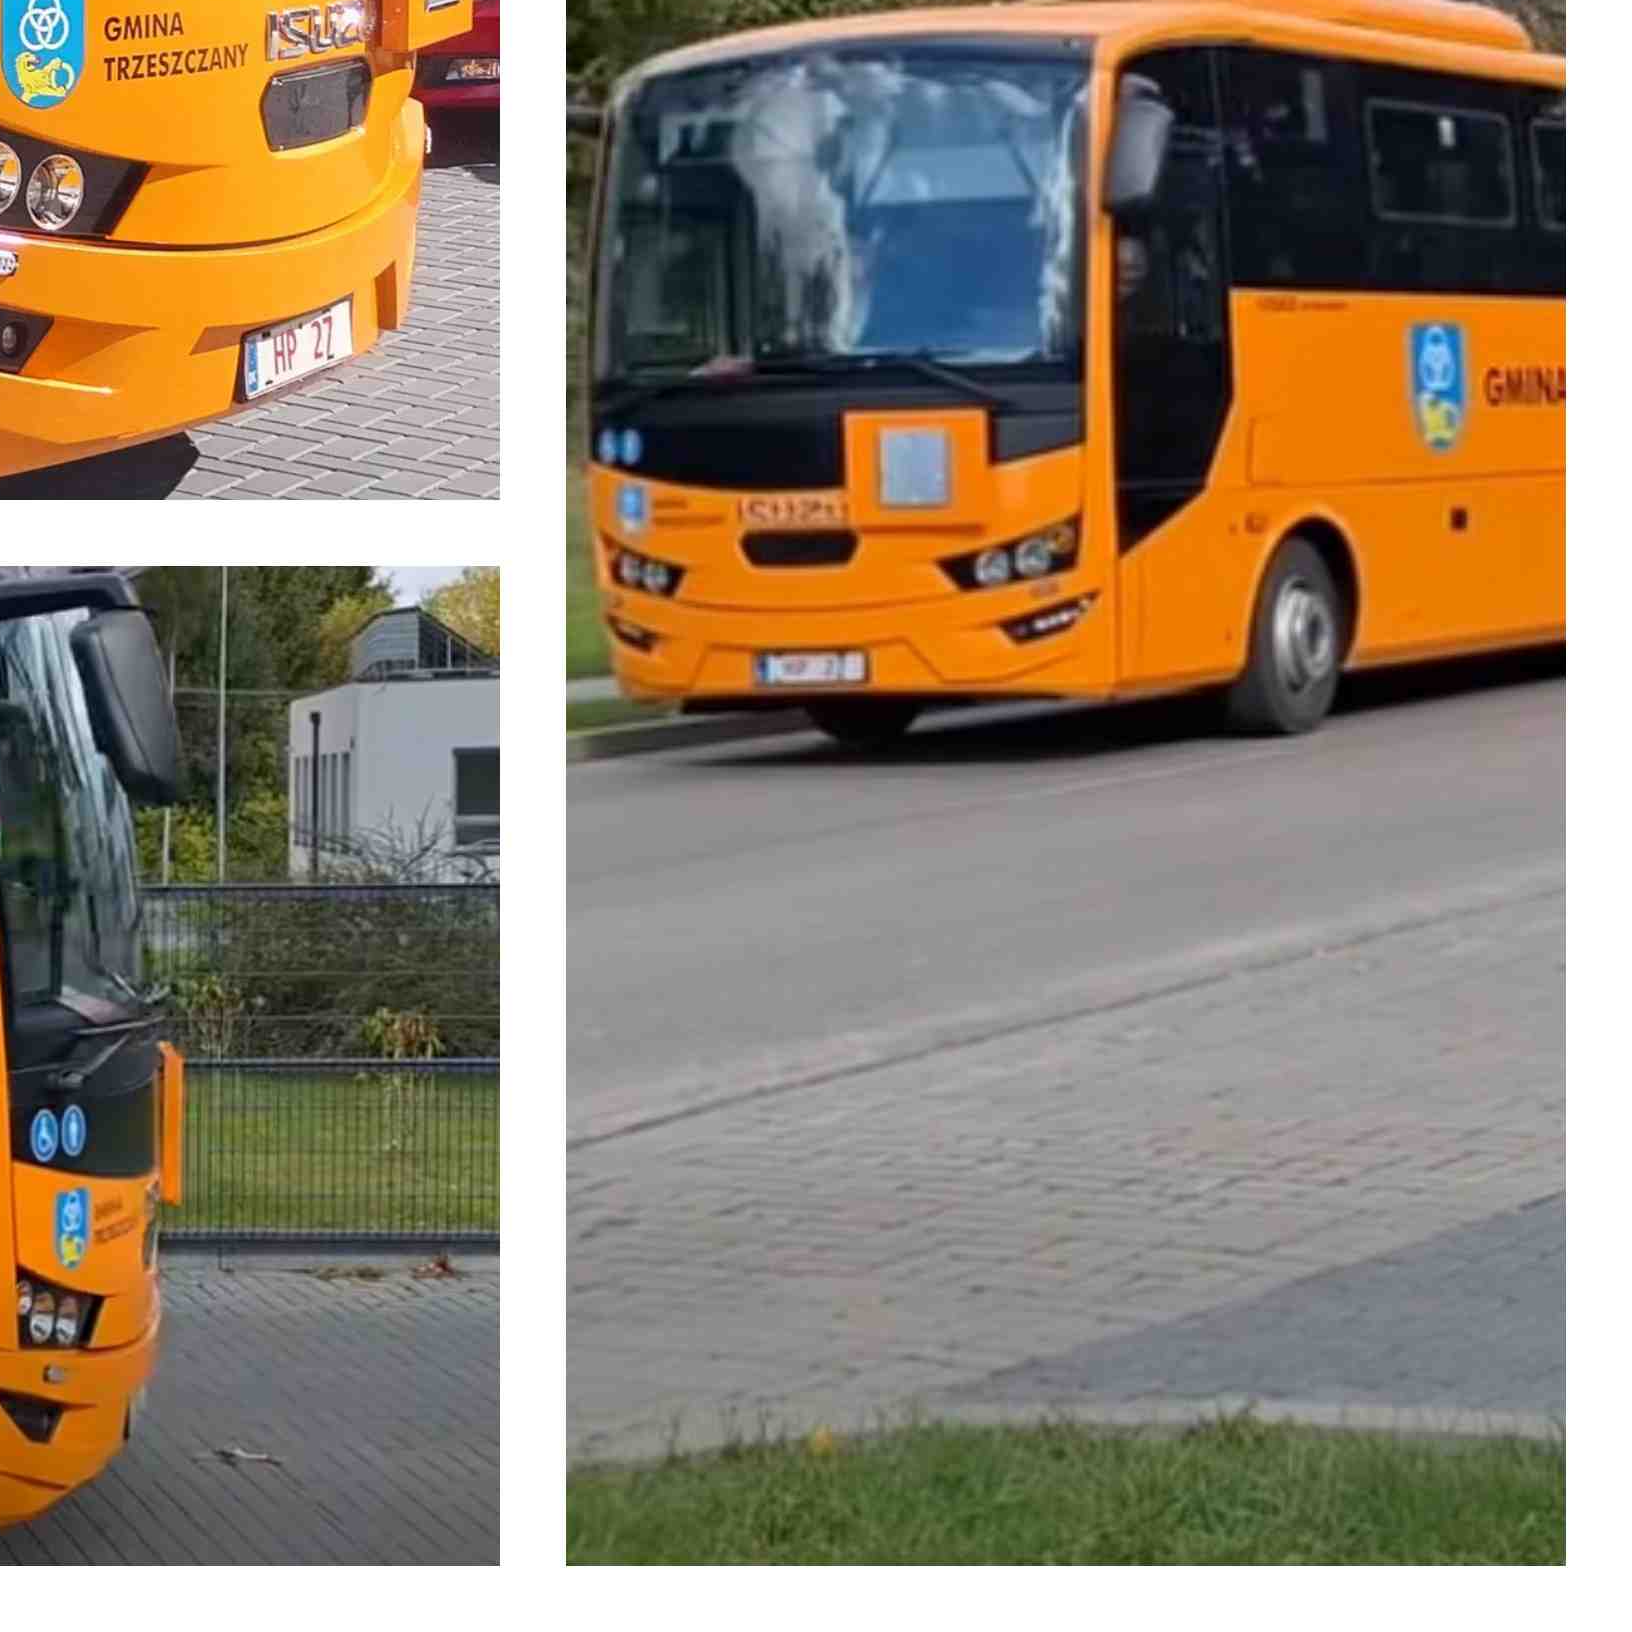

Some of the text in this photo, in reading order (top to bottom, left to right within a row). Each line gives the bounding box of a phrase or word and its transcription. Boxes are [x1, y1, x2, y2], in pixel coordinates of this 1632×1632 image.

[104, 11, 184, 41] GMINA
[104, 43, 248, 82] TRZESZCZANY
[273, 328, 297, 375] HP
